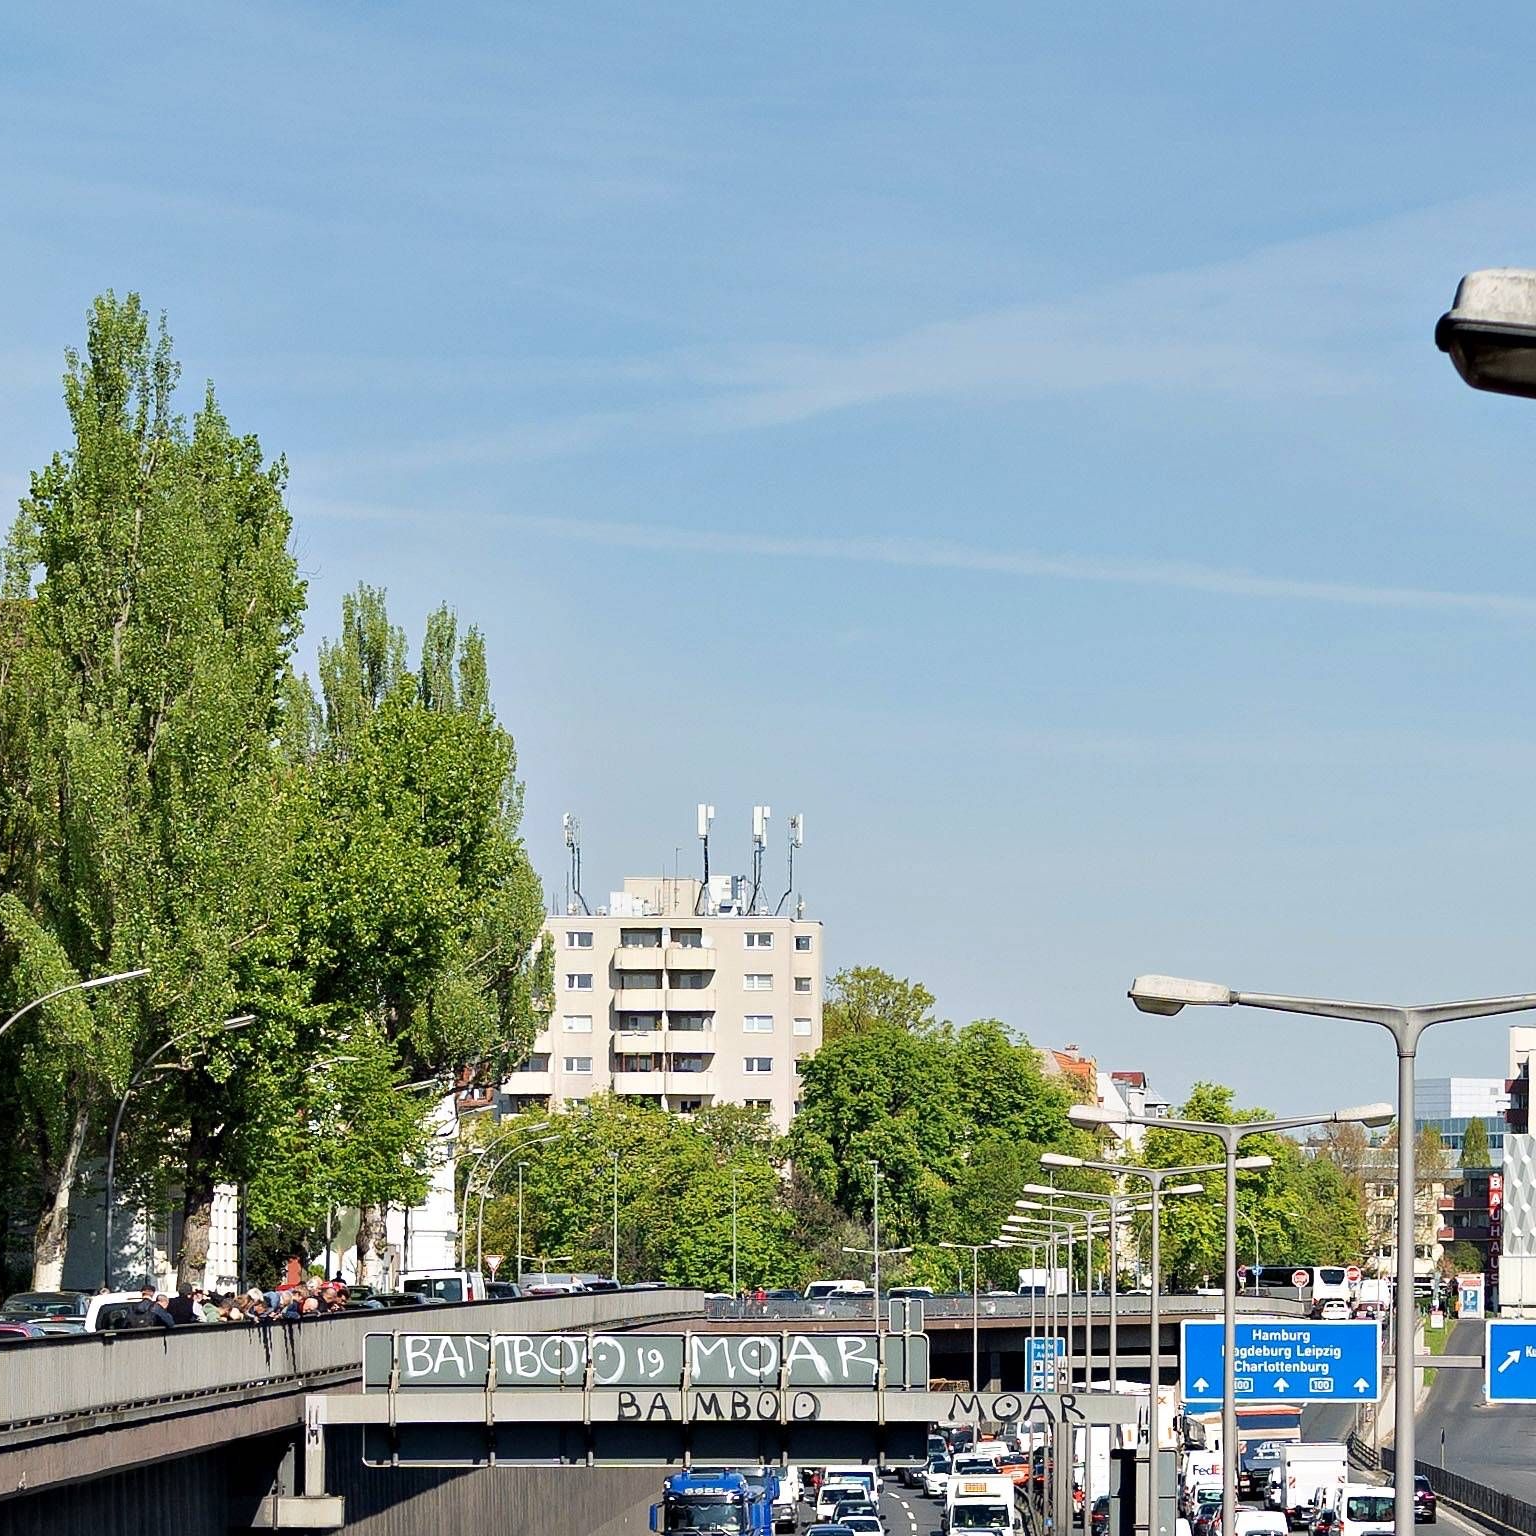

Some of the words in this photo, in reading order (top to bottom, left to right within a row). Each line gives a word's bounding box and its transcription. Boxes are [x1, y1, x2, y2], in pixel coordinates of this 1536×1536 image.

[1252, 1329, 1311, 1344] Hamburg
[1221, 1345, 1292, 1360] agdeburg
[1296, 1345, 1342, 1360] Leipzig
[690, 1336, 879, 1385] MOAR
[1234, 1361, 1330, 1376] Charlottenburg
[1313, 1381, 1330, 1390] 100
[948, 1393, 1086, 1424] MOAR
[1193, 1464, 1223, 1476] FedE
